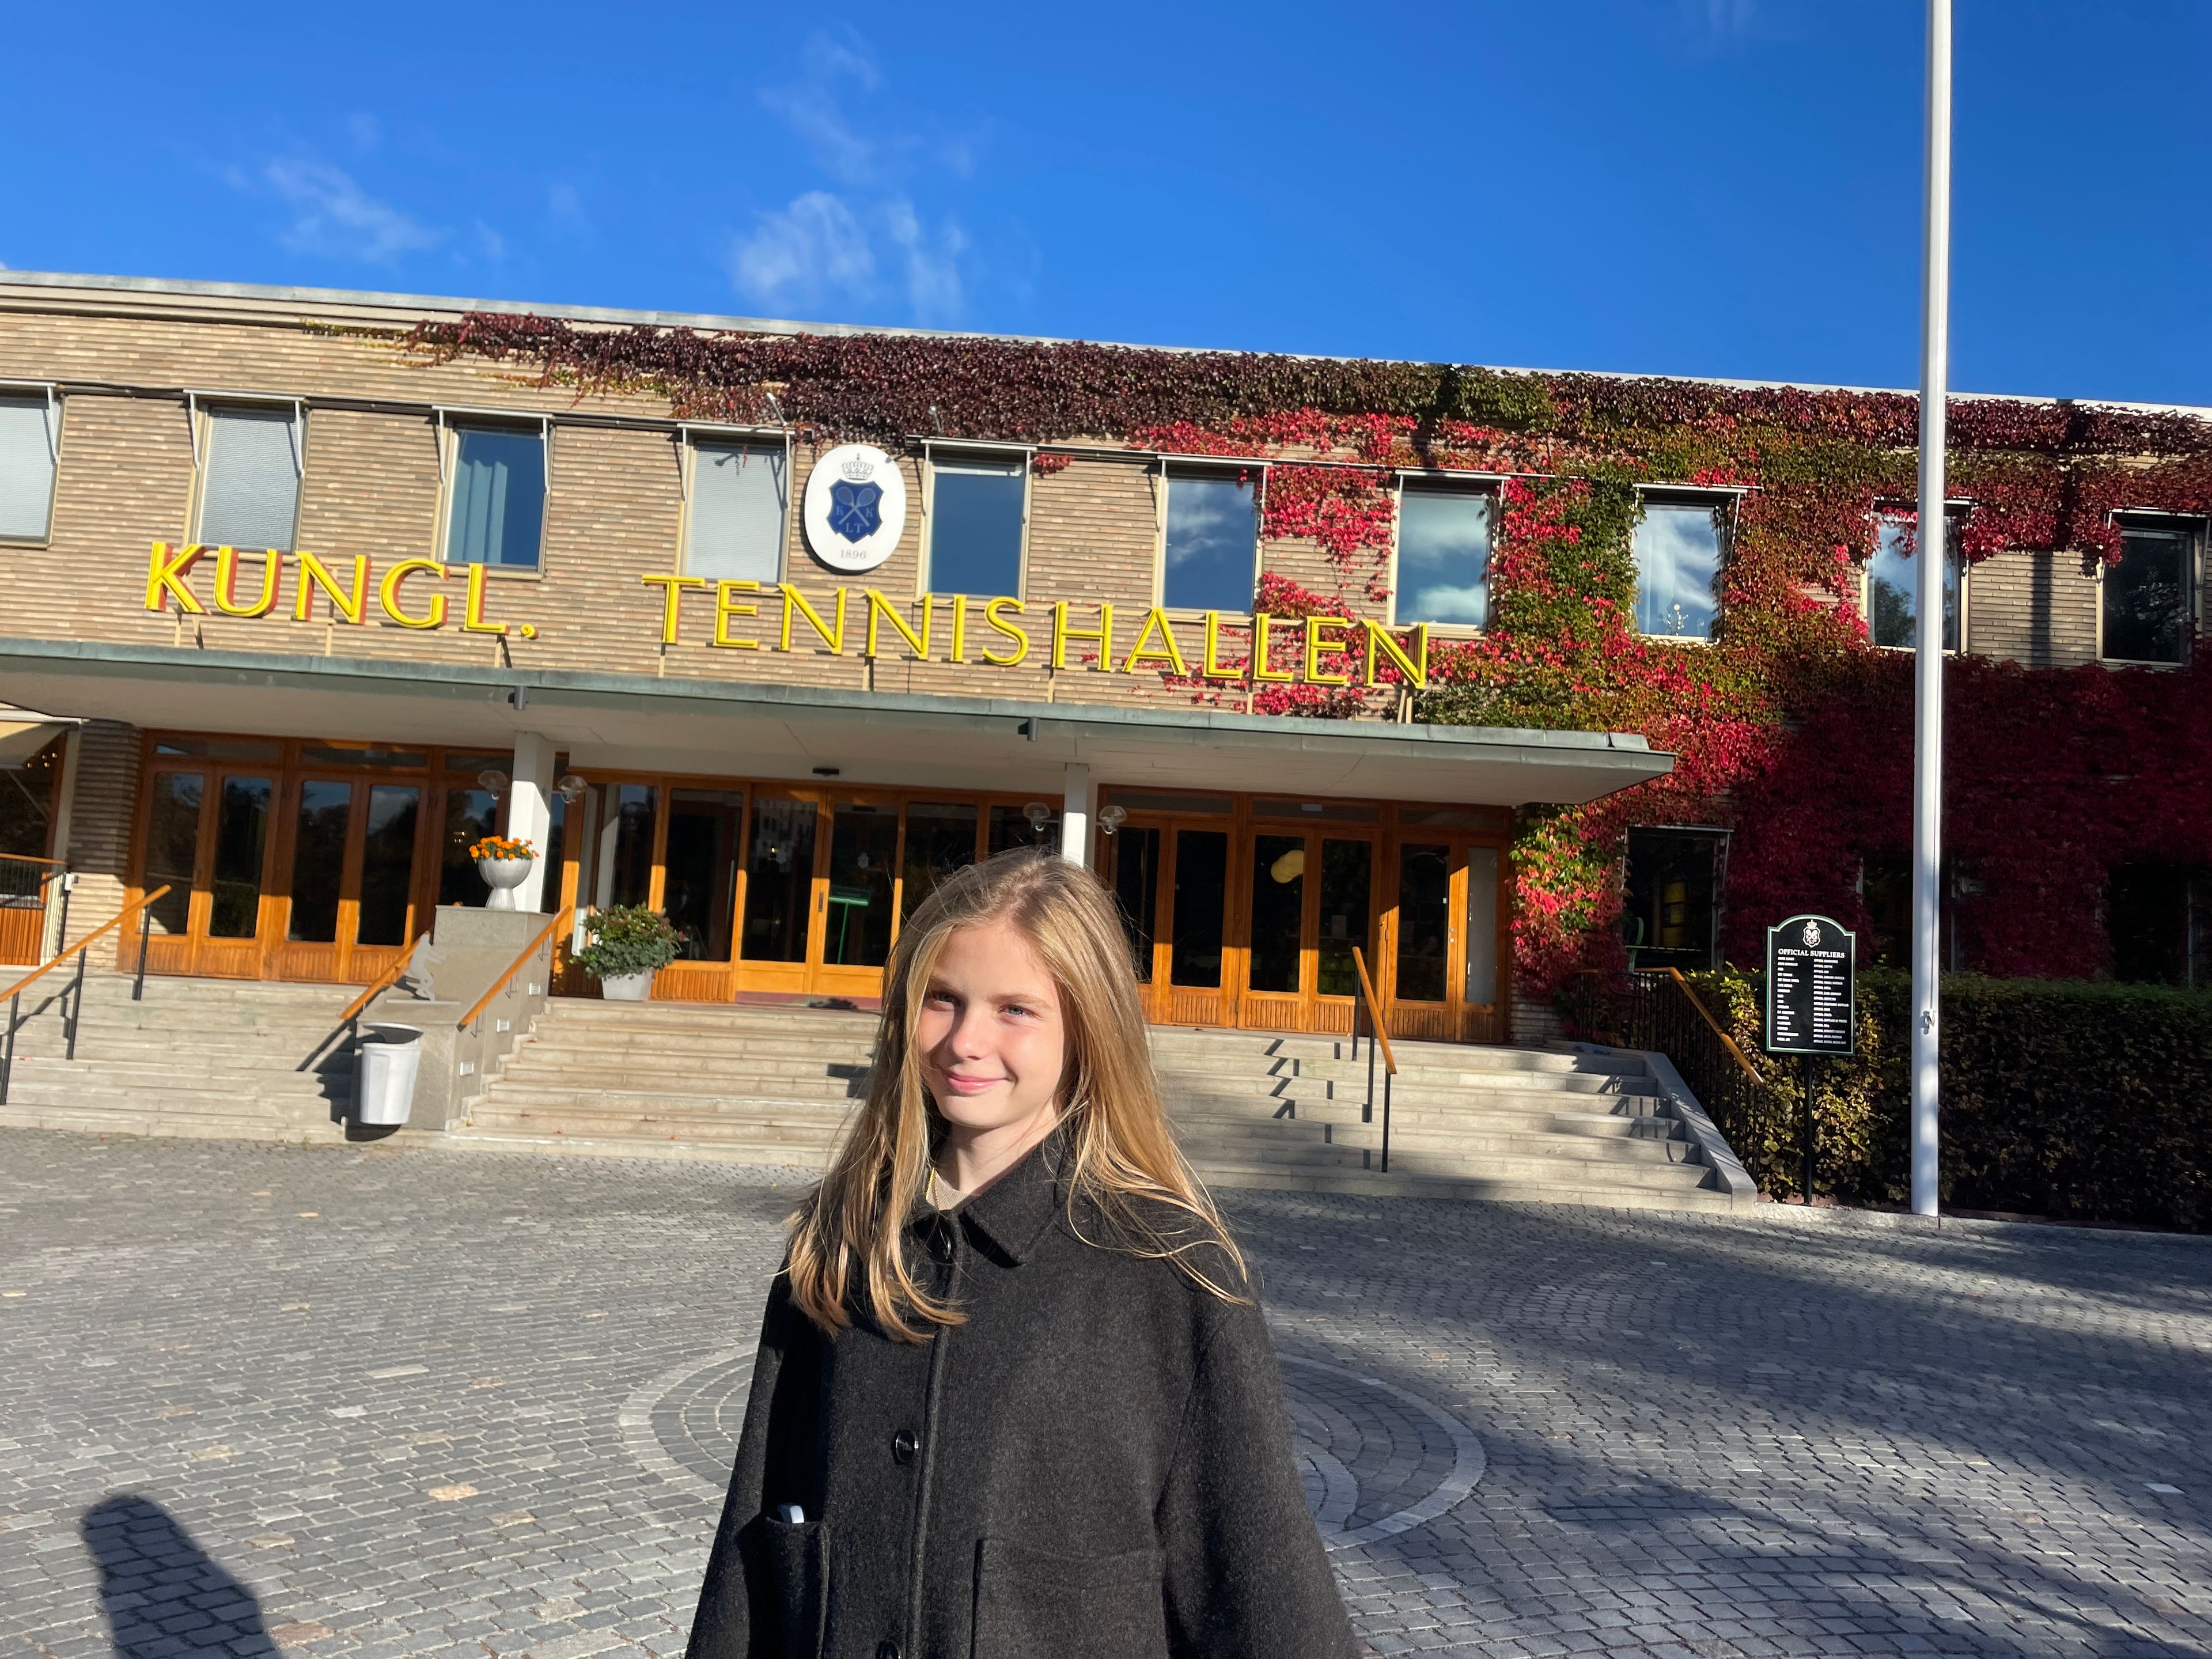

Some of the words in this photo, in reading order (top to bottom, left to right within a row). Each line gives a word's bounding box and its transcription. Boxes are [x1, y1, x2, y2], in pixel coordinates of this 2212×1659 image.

[839, 549, 866, 559] 1896
[144, 541, 540, 639] KUNGL.
[641, 574, 1427, 690] TENNISHALLEN
[1778, 948, 1809, 957] OFFICIAL
[1810, 950, 1845, 959] SUPPLIERS
